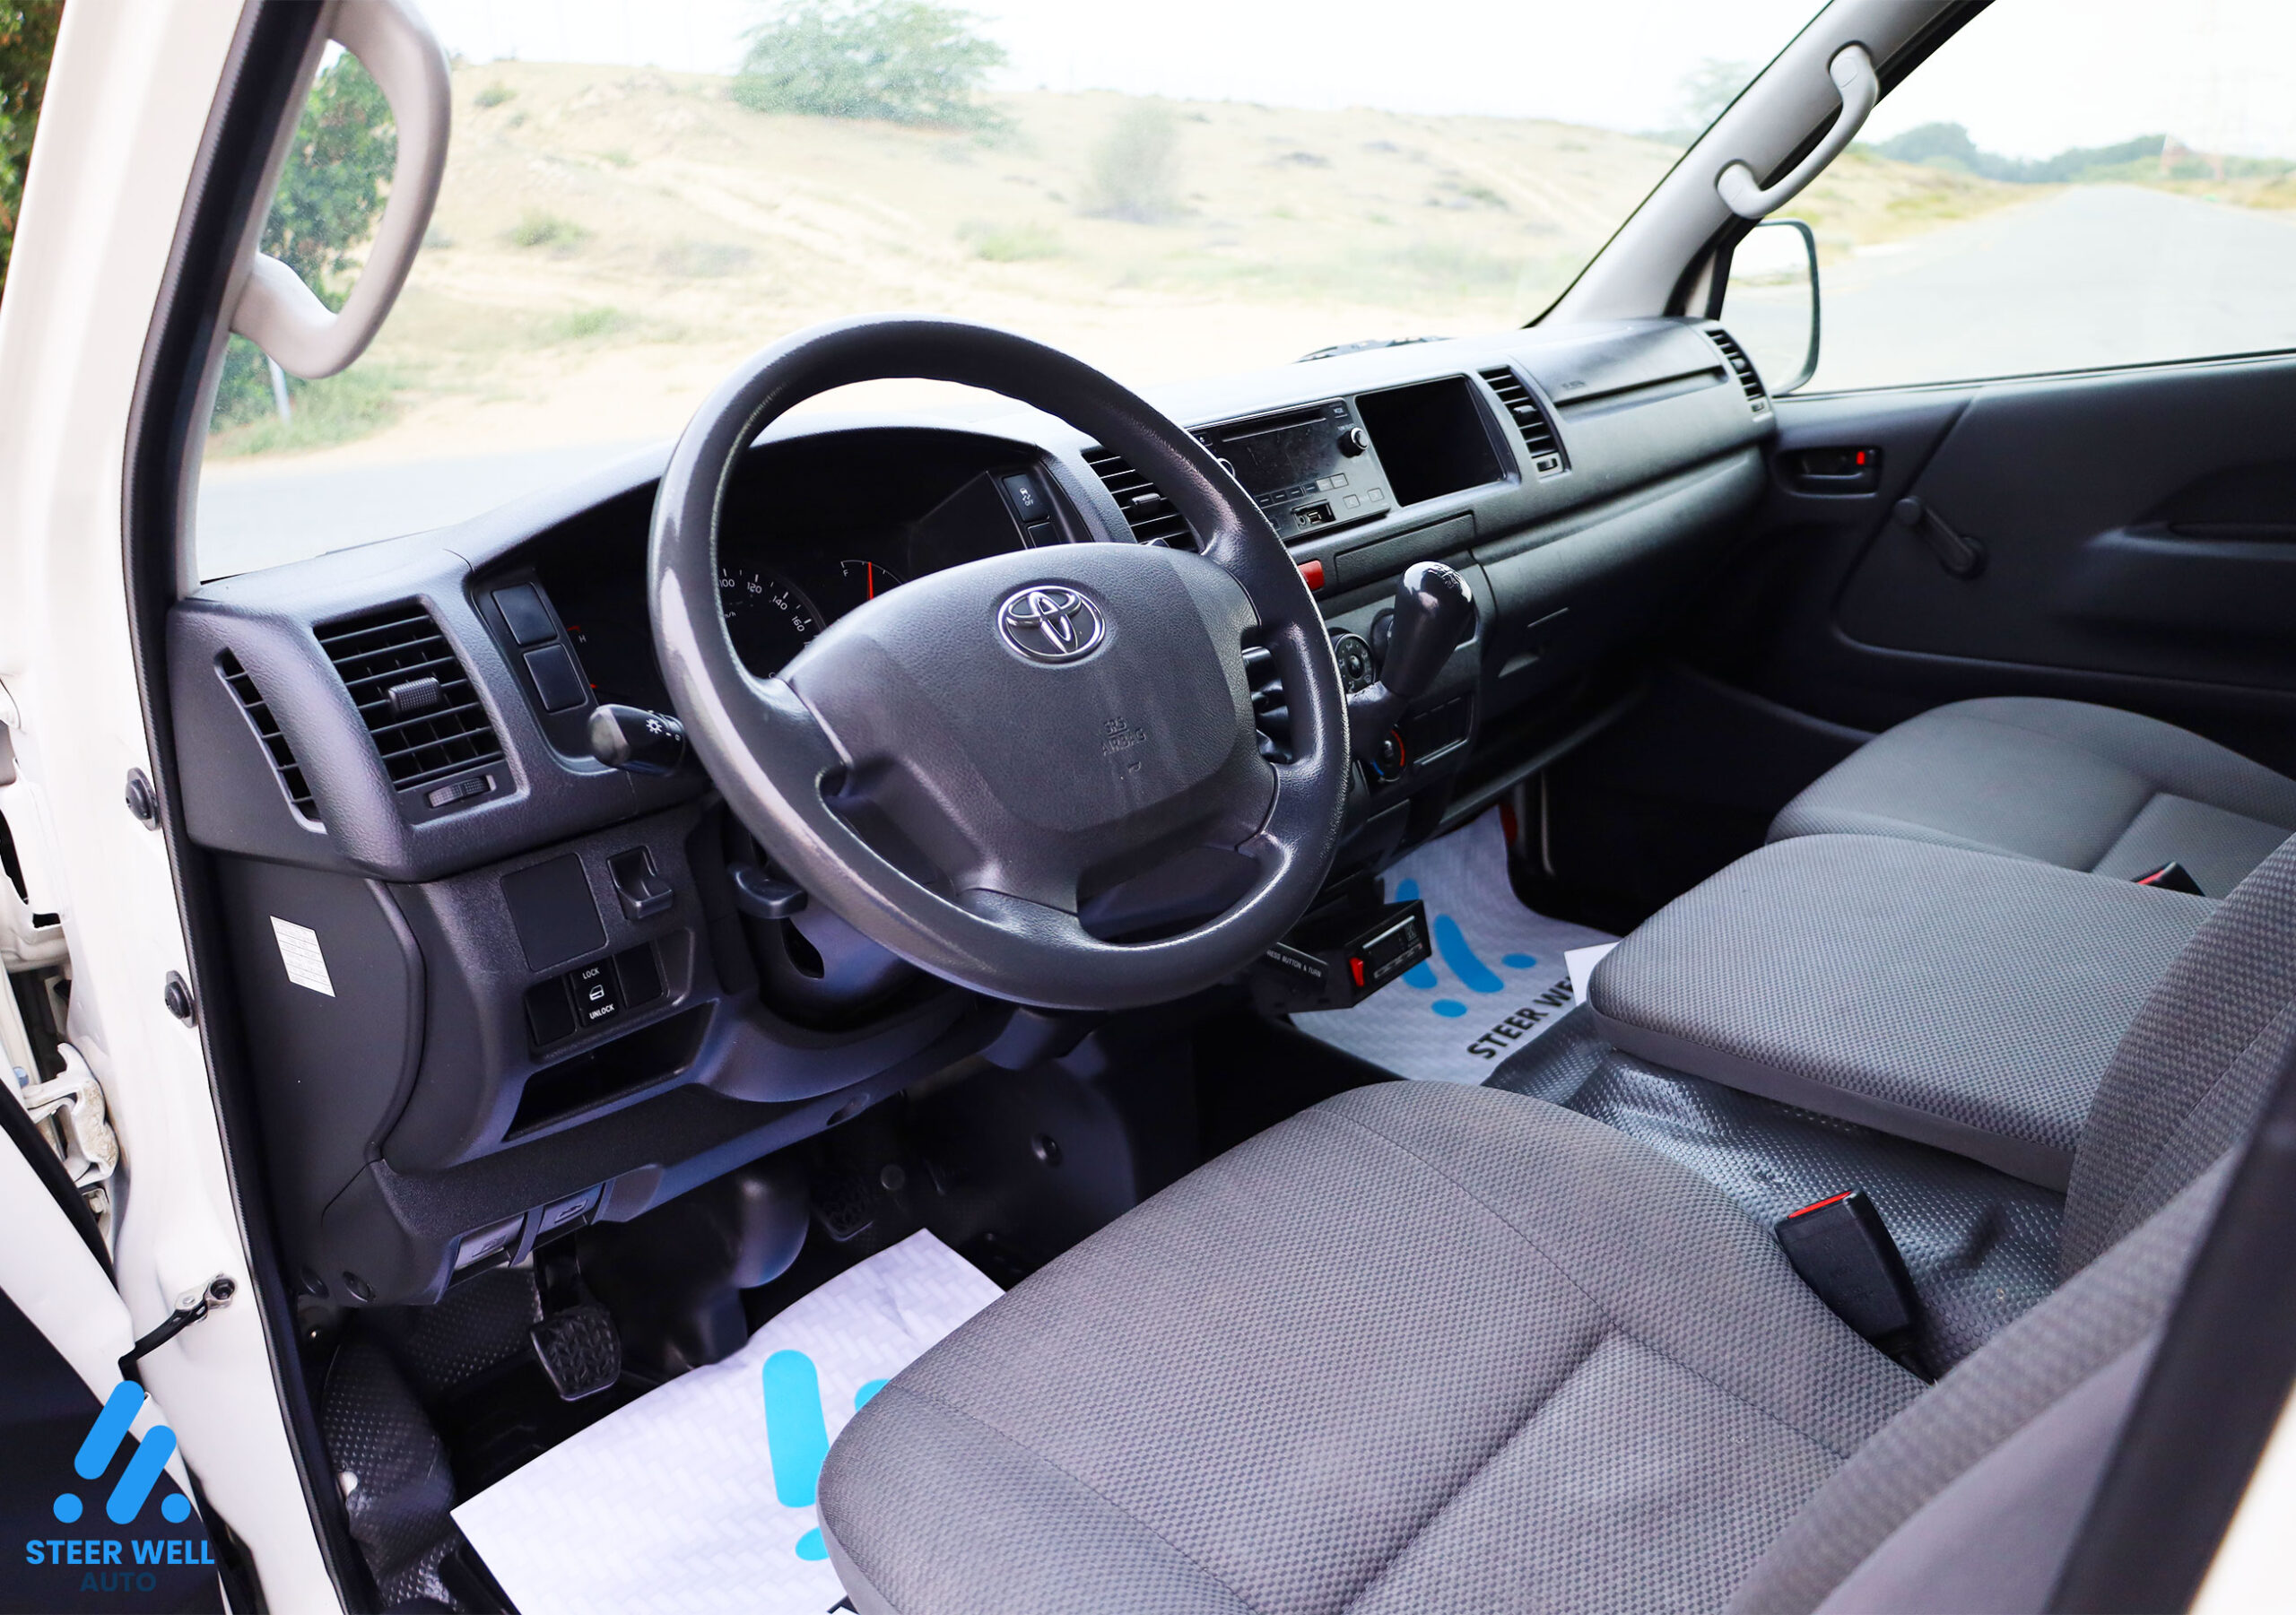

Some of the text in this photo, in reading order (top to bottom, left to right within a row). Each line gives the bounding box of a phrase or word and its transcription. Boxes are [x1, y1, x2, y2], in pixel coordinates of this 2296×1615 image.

[719, 578, 735, 588] 100
[747, 581, 762, 594] 120
[772, 595, 788, 611] 140
[791, 615, 805, 632] 160
[578, 634, 587, 643] H
[1100, 726, 1147, 757] AIRBAG
[582, 968, 600, 980] LOCK
[1282, 955, 1302, 969] BUTTON
[1309, 967, 1322, 978] TURN
[589, 1004, 614, 1020] UNLOCK
[1467, 1008, 1549, 1059] STEER
